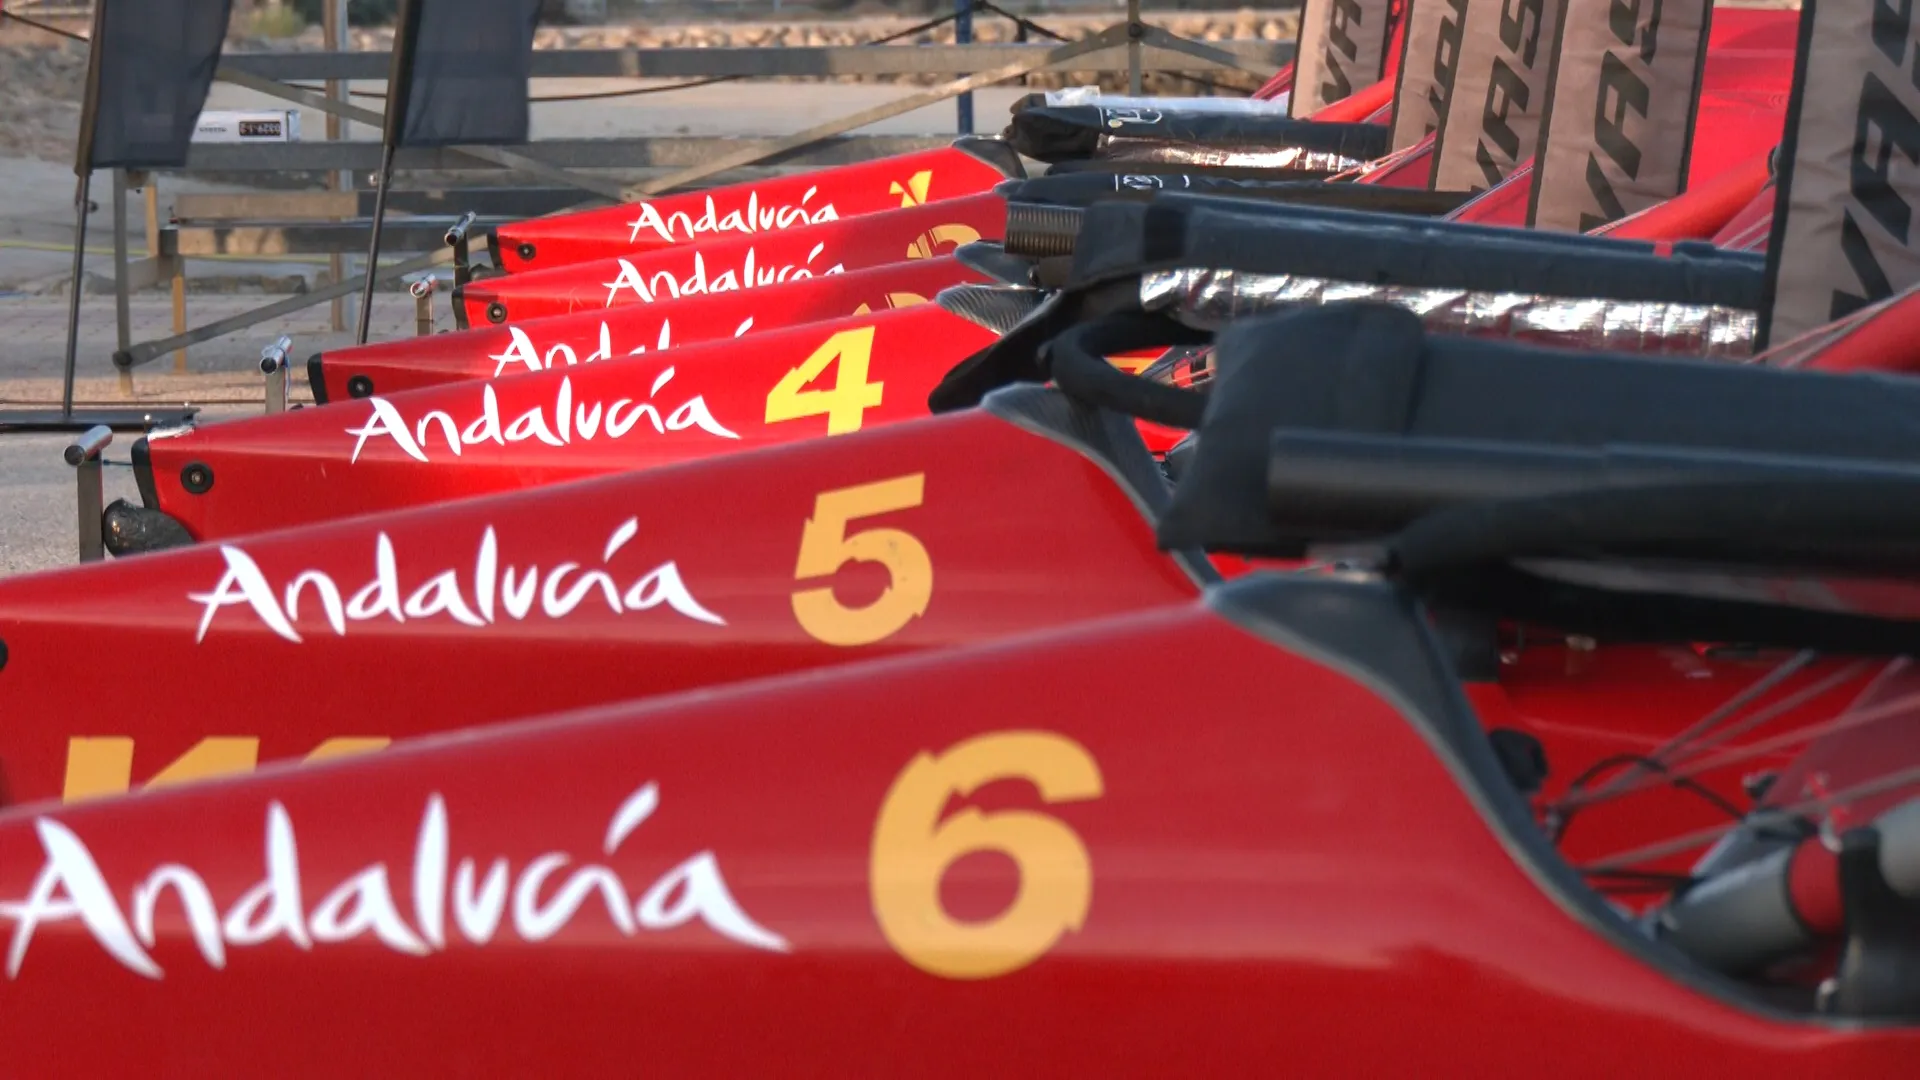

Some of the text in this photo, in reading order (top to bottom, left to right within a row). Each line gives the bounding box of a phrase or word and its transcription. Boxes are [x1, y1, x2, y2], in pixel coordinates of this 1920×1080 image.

[627, 186, 840, 244] Andalucía
[345, 365, 742, 464] Andalucía
[764, 325, 884, 436] 4
[188, 472, 933, 645] Andalucía 5
[0, 729, 1105, 981] Andalucía 6
